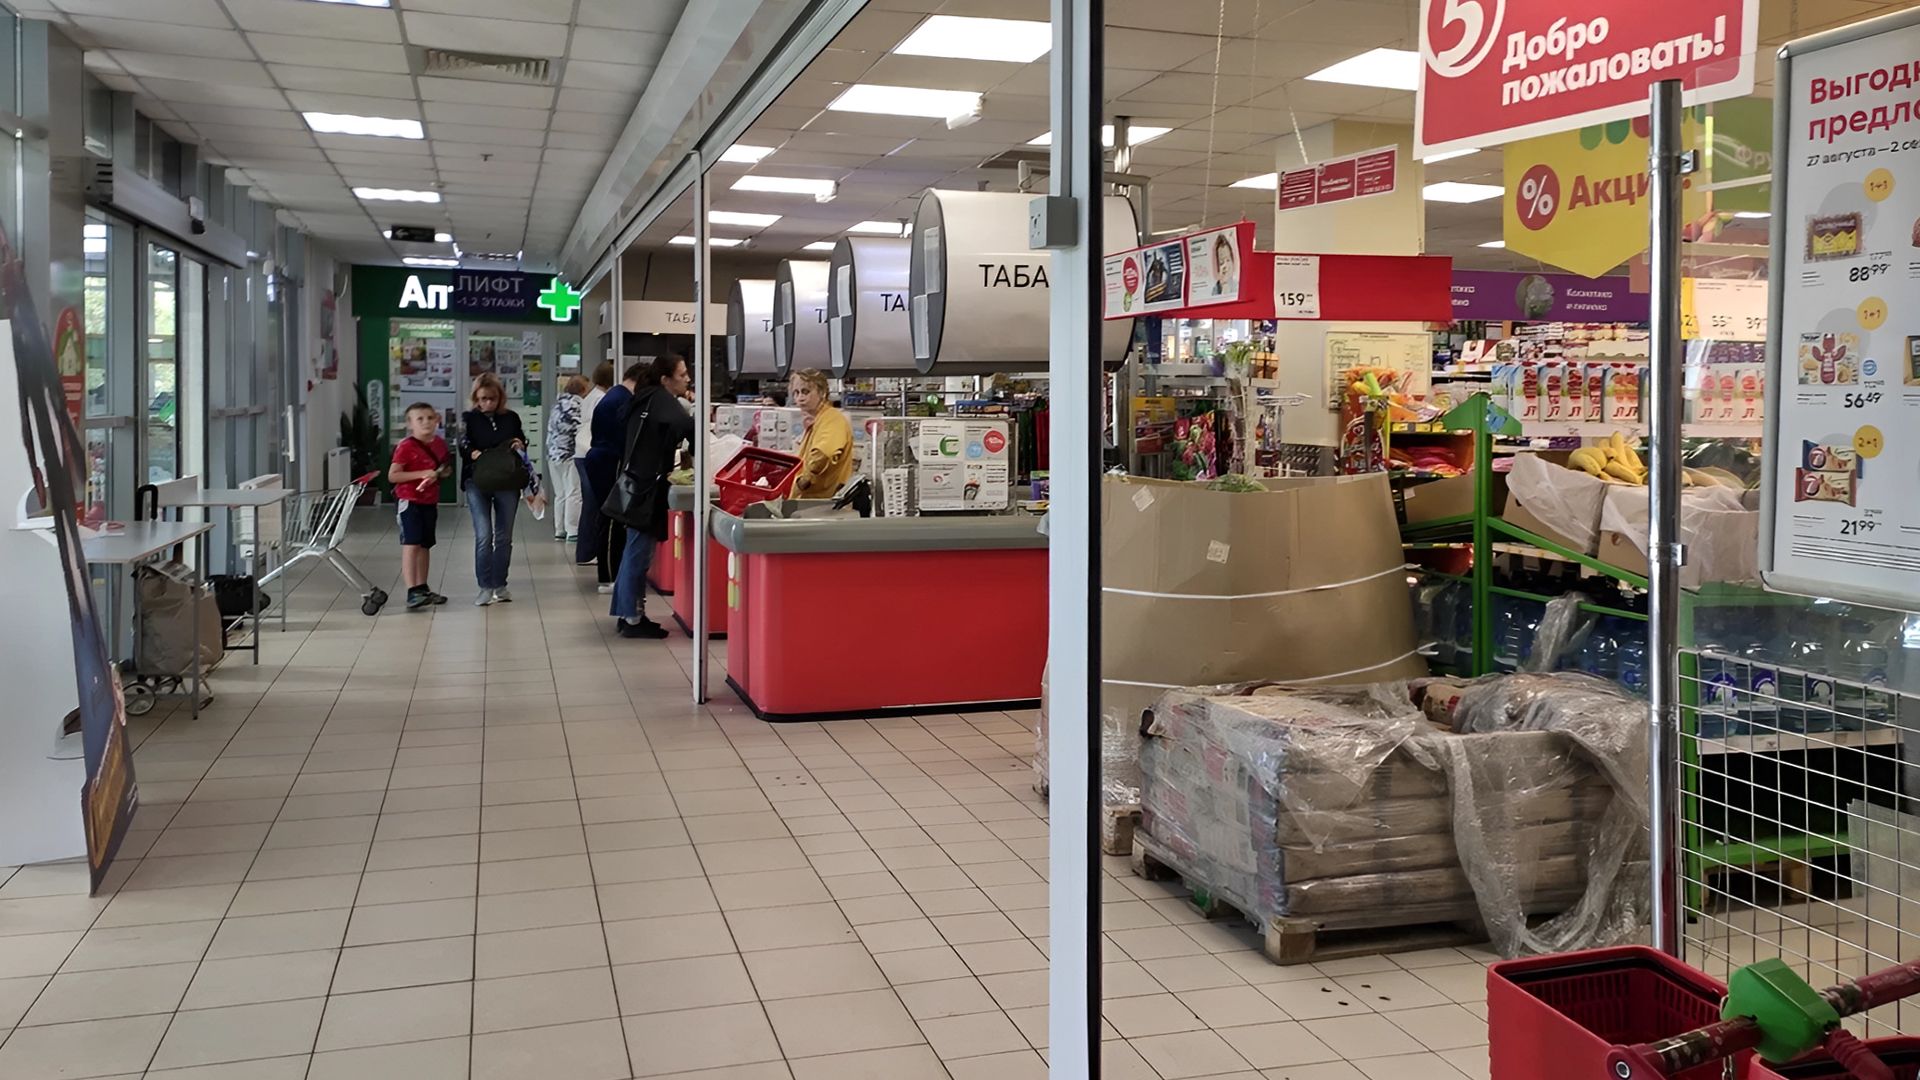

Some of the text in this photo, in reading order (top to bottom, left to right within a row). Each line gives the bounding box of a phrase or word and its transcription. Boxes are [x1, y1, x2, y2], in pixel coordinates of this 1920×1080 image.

[1501, 15, 1727, 107] пожаловать!
[1502, 16, 1609, 74] Добро
[1567, 172, 1691, 211] Акци
[457, 275, 524, 293] ЛИФТ
[880, 294, 909, 312] ТА
